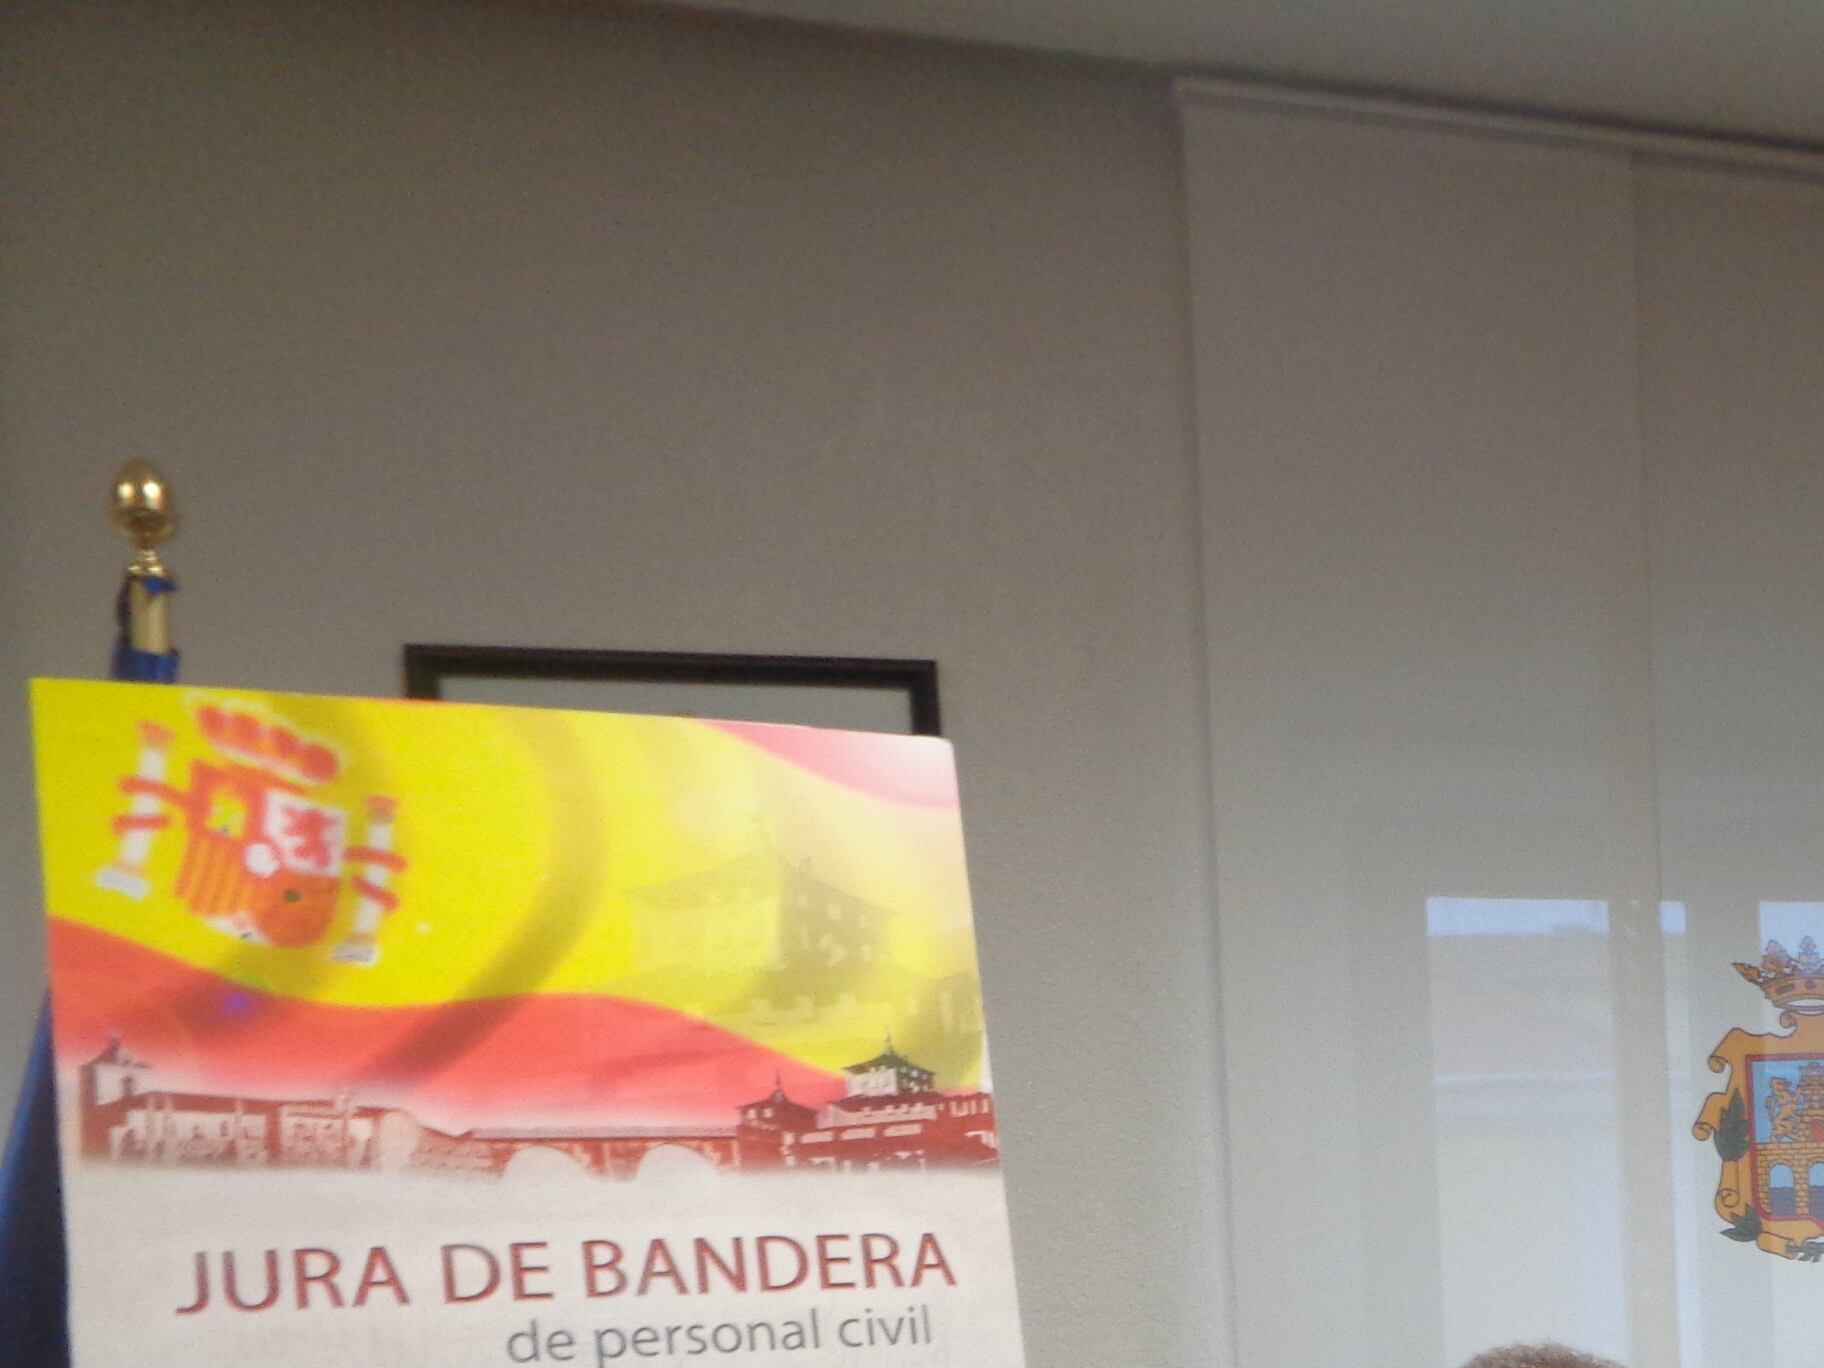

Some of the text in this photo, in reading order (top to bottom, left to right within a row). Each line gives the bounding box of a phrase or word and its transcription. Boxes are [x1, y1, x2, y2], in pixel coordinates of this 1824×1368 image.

[175, 1233, 957, 1316] JURA DE BANDERA
[506, 1319, 575, 1363] de
[839, 1304, 932, 1347] civil
